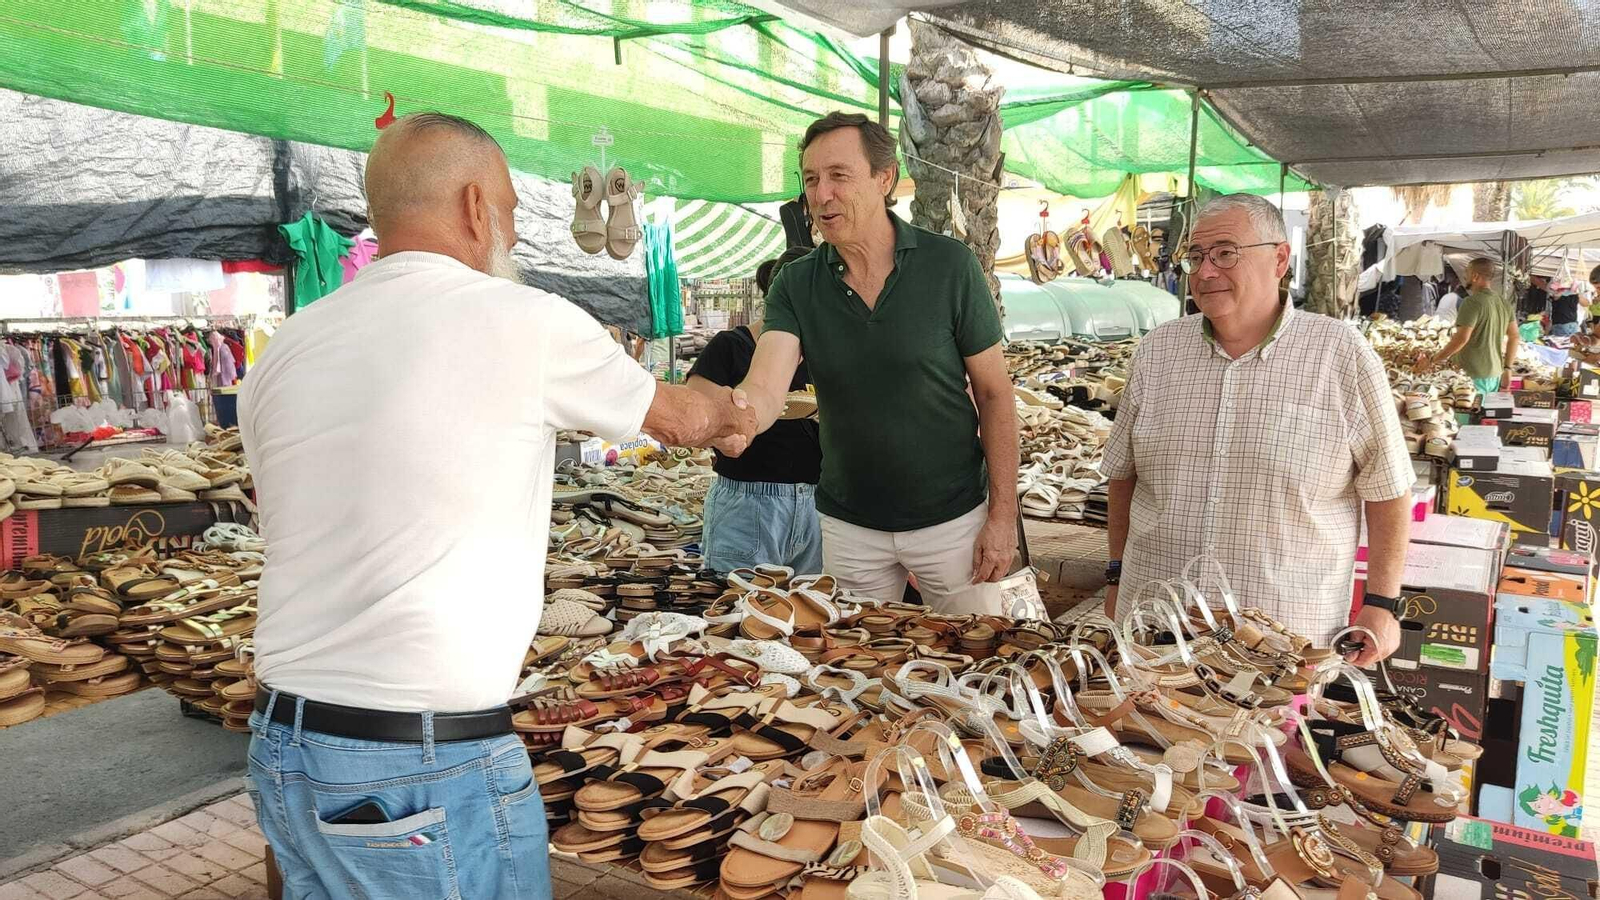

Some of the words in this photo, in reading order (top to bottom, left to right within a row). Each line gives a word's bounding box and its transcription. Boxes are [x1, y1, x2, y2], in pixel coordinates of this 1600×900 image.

[619, 438, 648, 451] Coplaca
[1427, 622, 1478, 644] IRIS
[1492, 825, 1586, 852] premium
